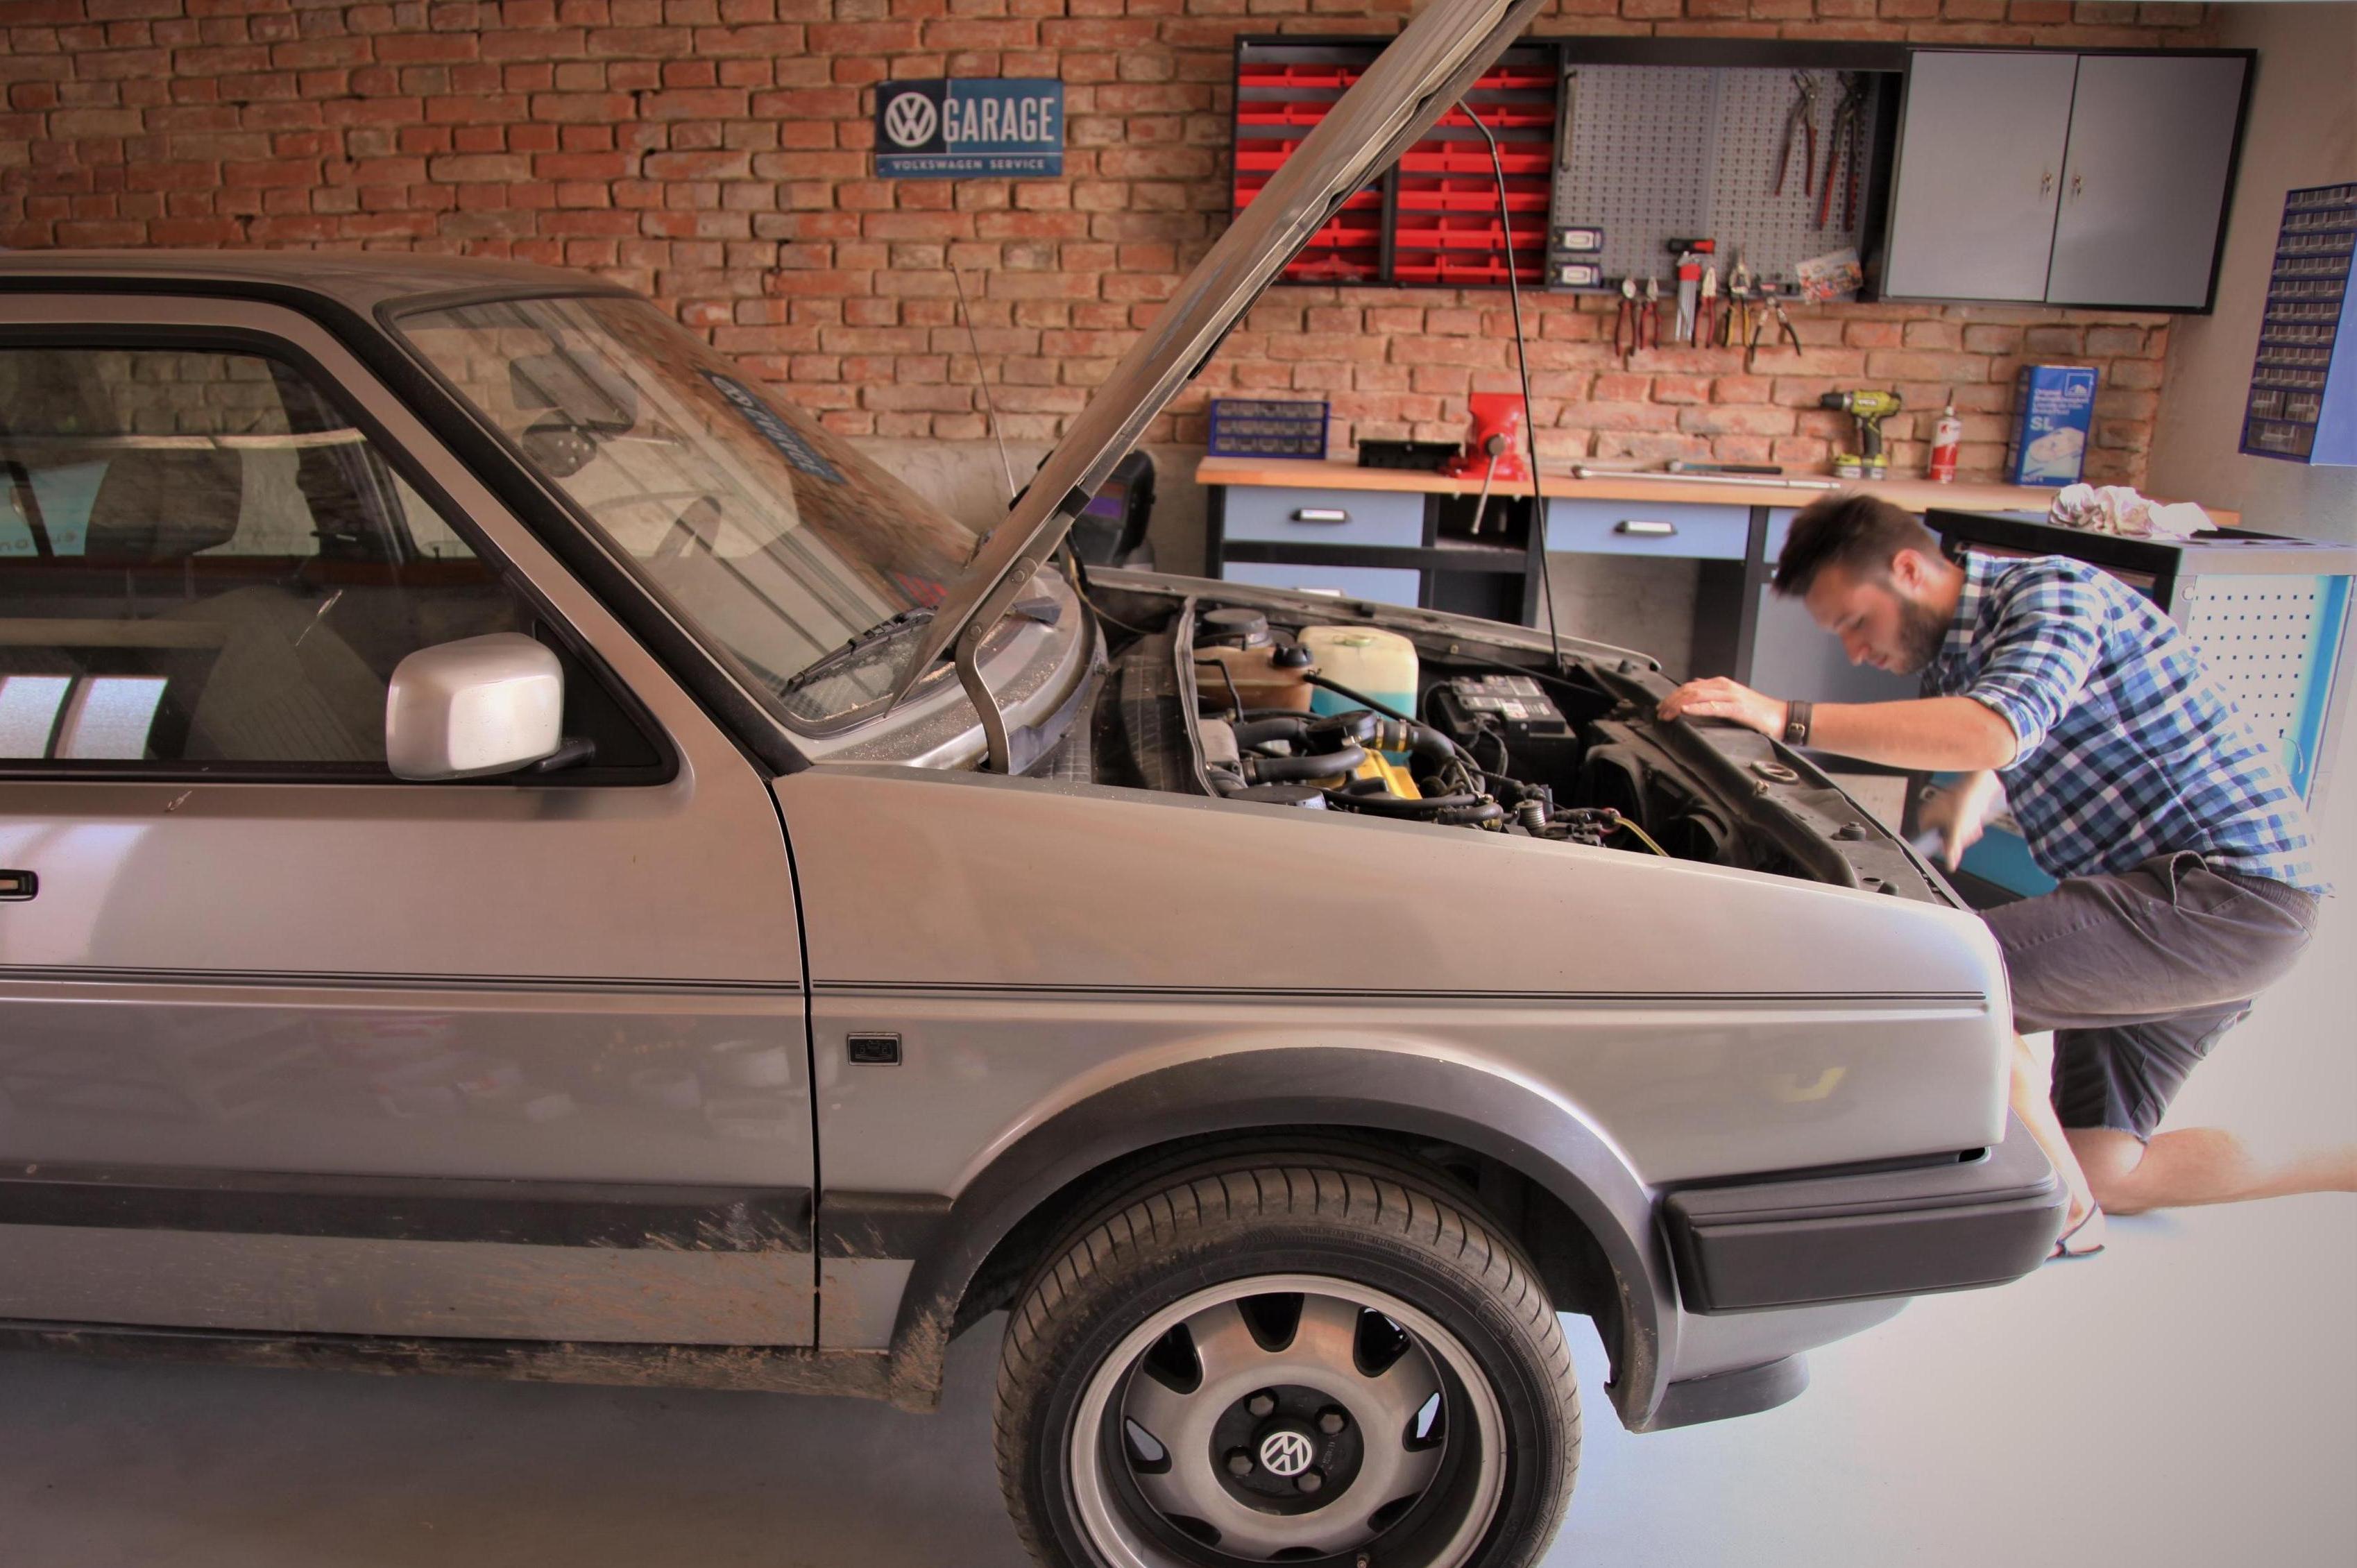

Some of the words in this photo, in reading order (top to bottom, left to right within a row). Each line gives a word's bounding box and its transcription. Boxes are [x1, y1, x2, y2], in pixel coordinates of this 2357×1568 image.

[942, 97, 1055, 143] GARAGE
[892, 160, 982, 170] VOLKSWAGEN
[989, 159, 1044, 169] SERVICE
[2030, 417, 2054, 431] SL
